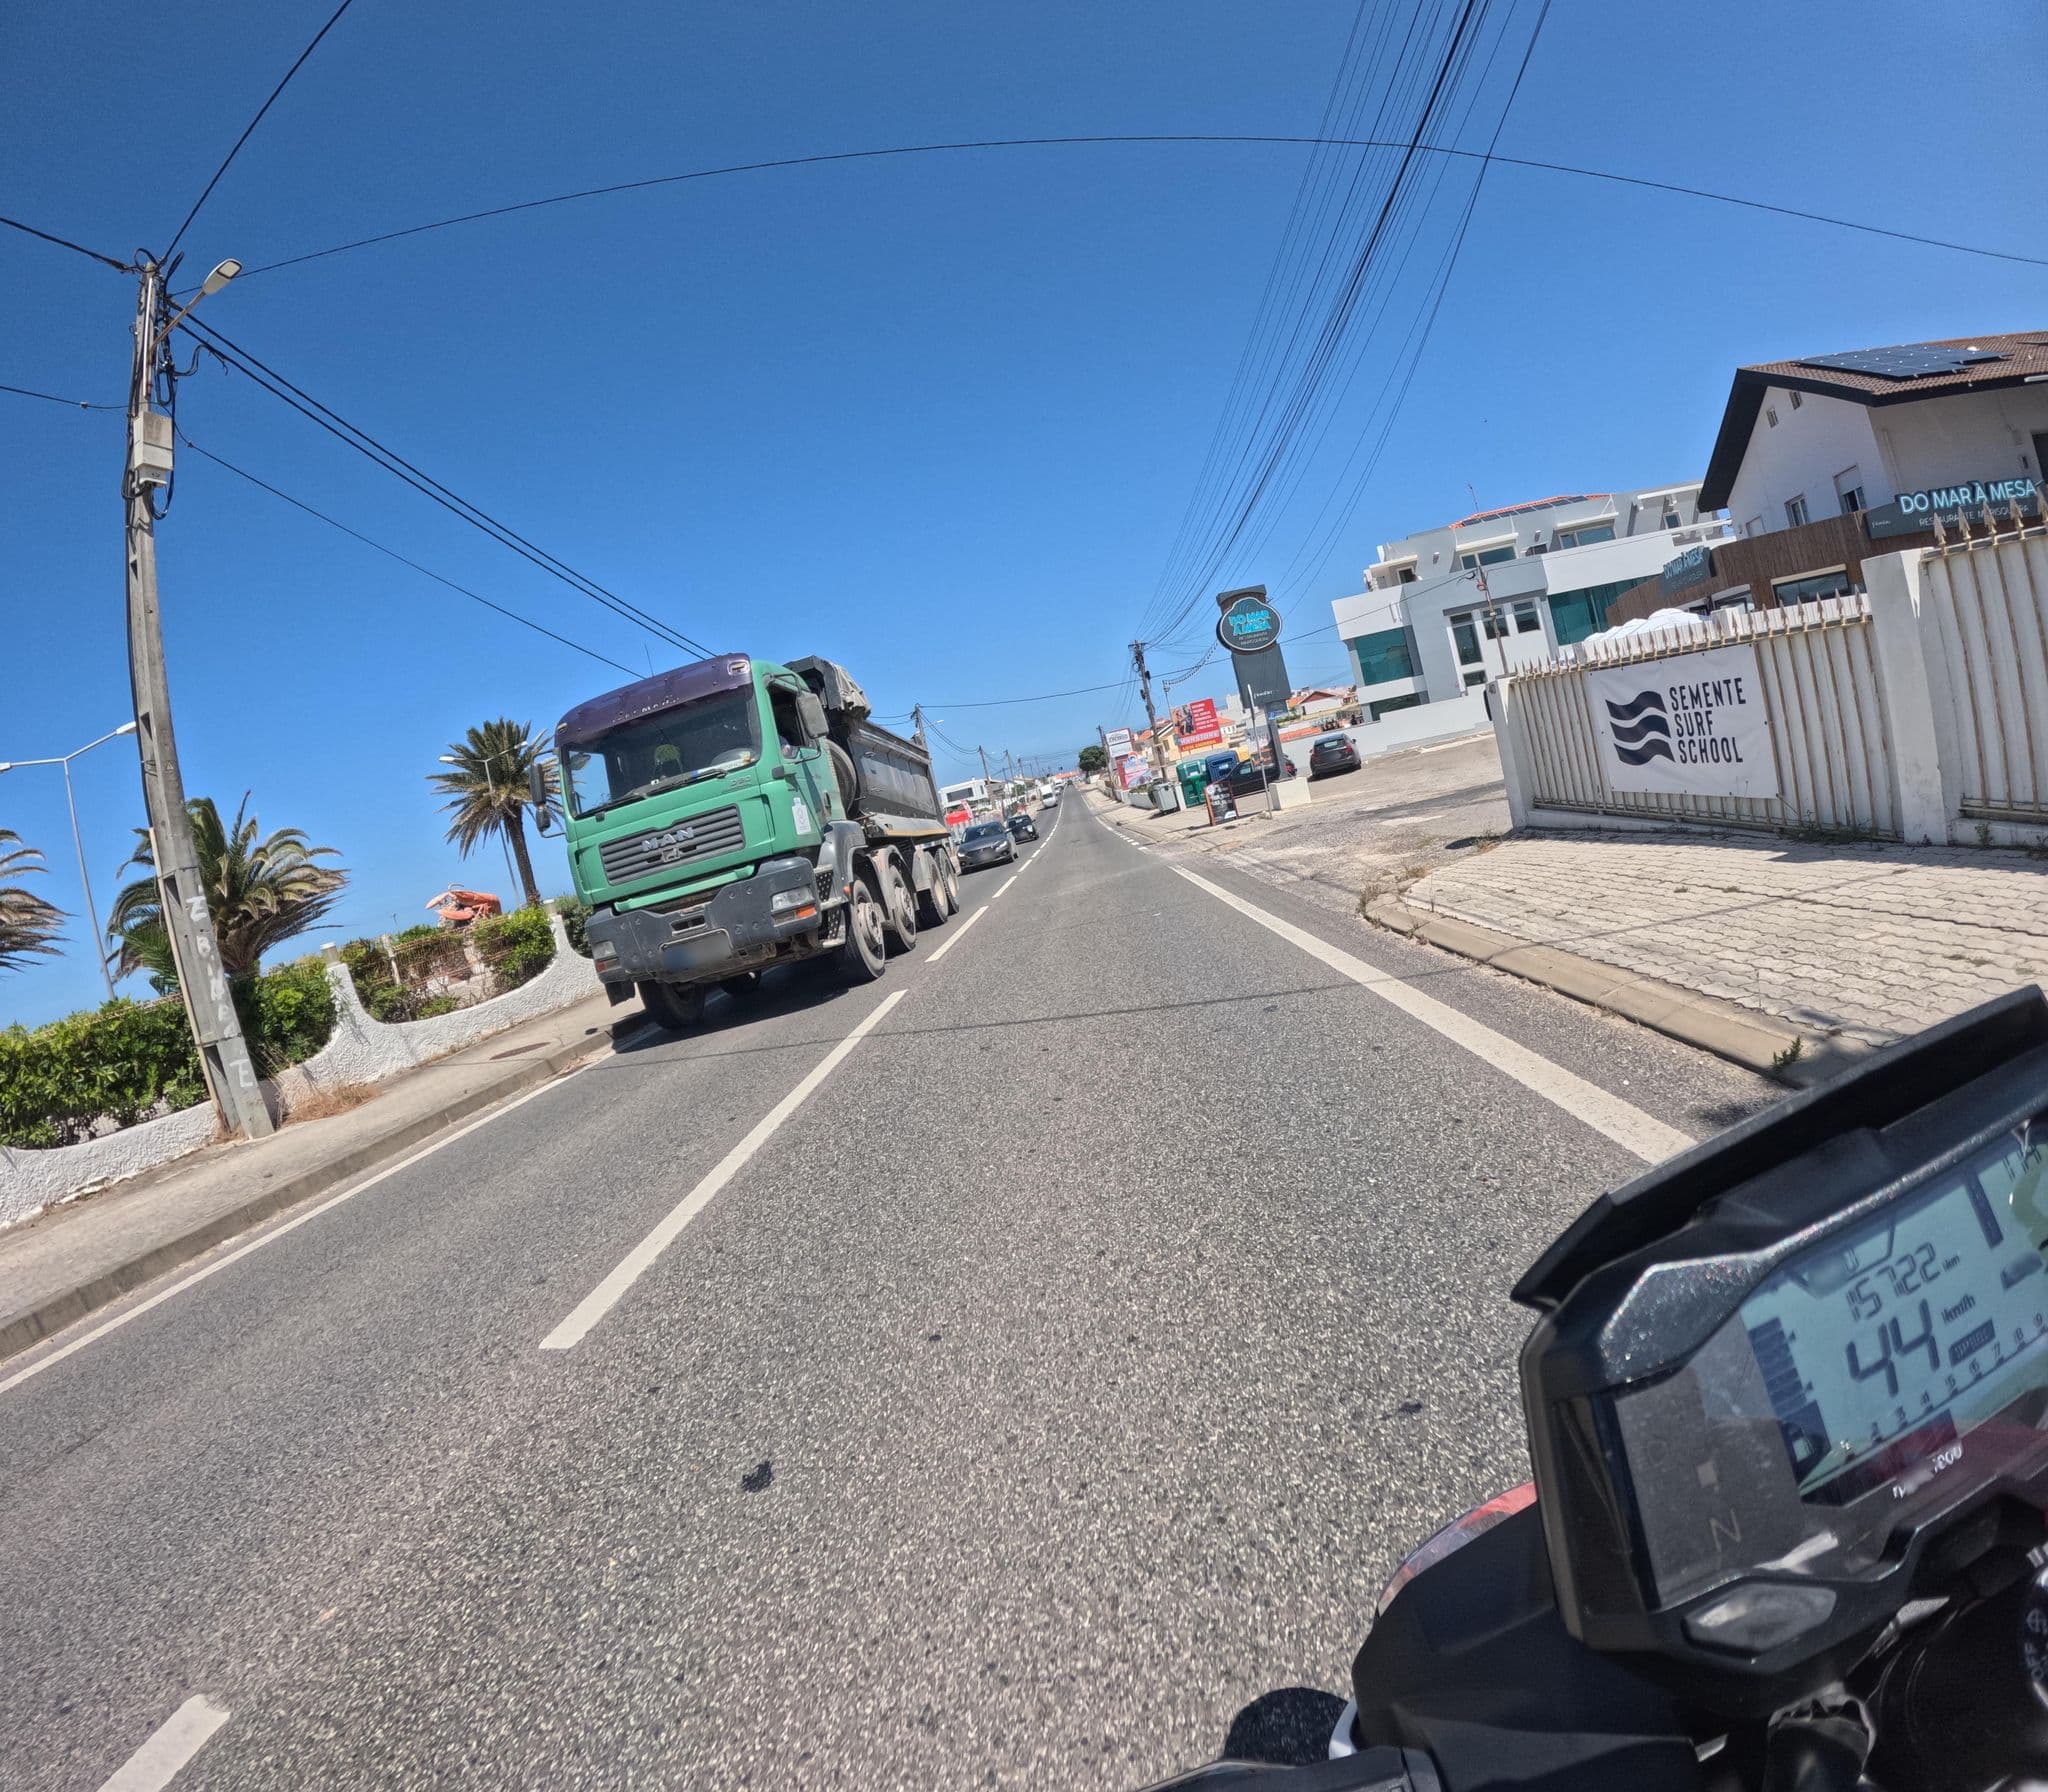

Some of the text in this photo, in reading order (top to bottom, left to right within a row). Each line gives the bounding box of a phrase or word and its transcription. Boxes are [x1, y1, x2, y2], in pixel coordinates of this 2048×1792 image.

[1900, 478, 2038, 515] DO MAR À MESA
[1669, 677, 1746, 711] SEMENTE
[1674, 710, 1713, 738] SURF
[1679, 737, 1744, 764] SCHOOL
[641, 826, 694, 852] MAN
[1846, 1242, 1940, 1322] 15722
[1846, 1298, 1940, 1397] 44
[1941, 1293, 1976, 1325] km/h
[1709, 1508, 1742, 1553] N
